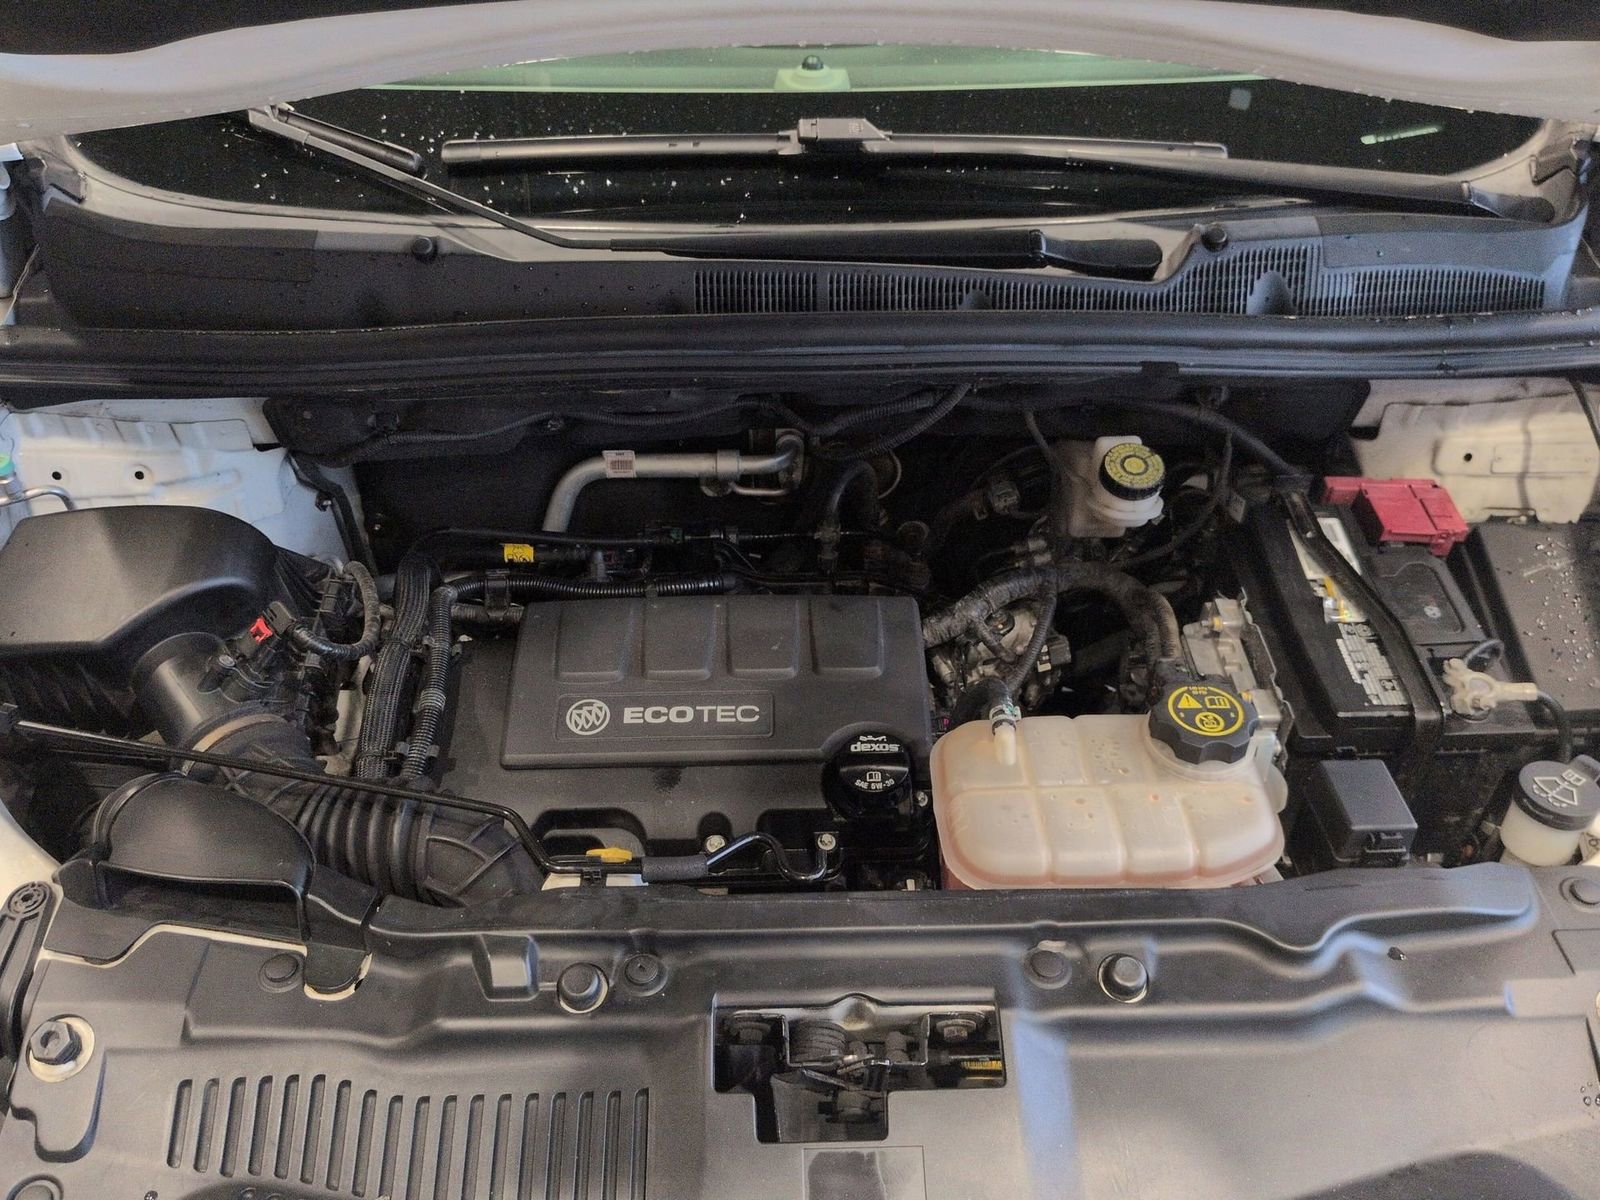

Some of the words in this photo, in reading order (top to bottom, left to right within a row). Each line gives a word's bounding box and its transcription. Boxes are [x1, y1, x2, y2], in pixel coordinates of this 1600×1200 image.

[623, 705, 760, 723] ECOTEC
[850, 741, 900, 752] dexos
[855, 779, 869, 789] SAE
[870, 778, 895, 790] 5W-30
